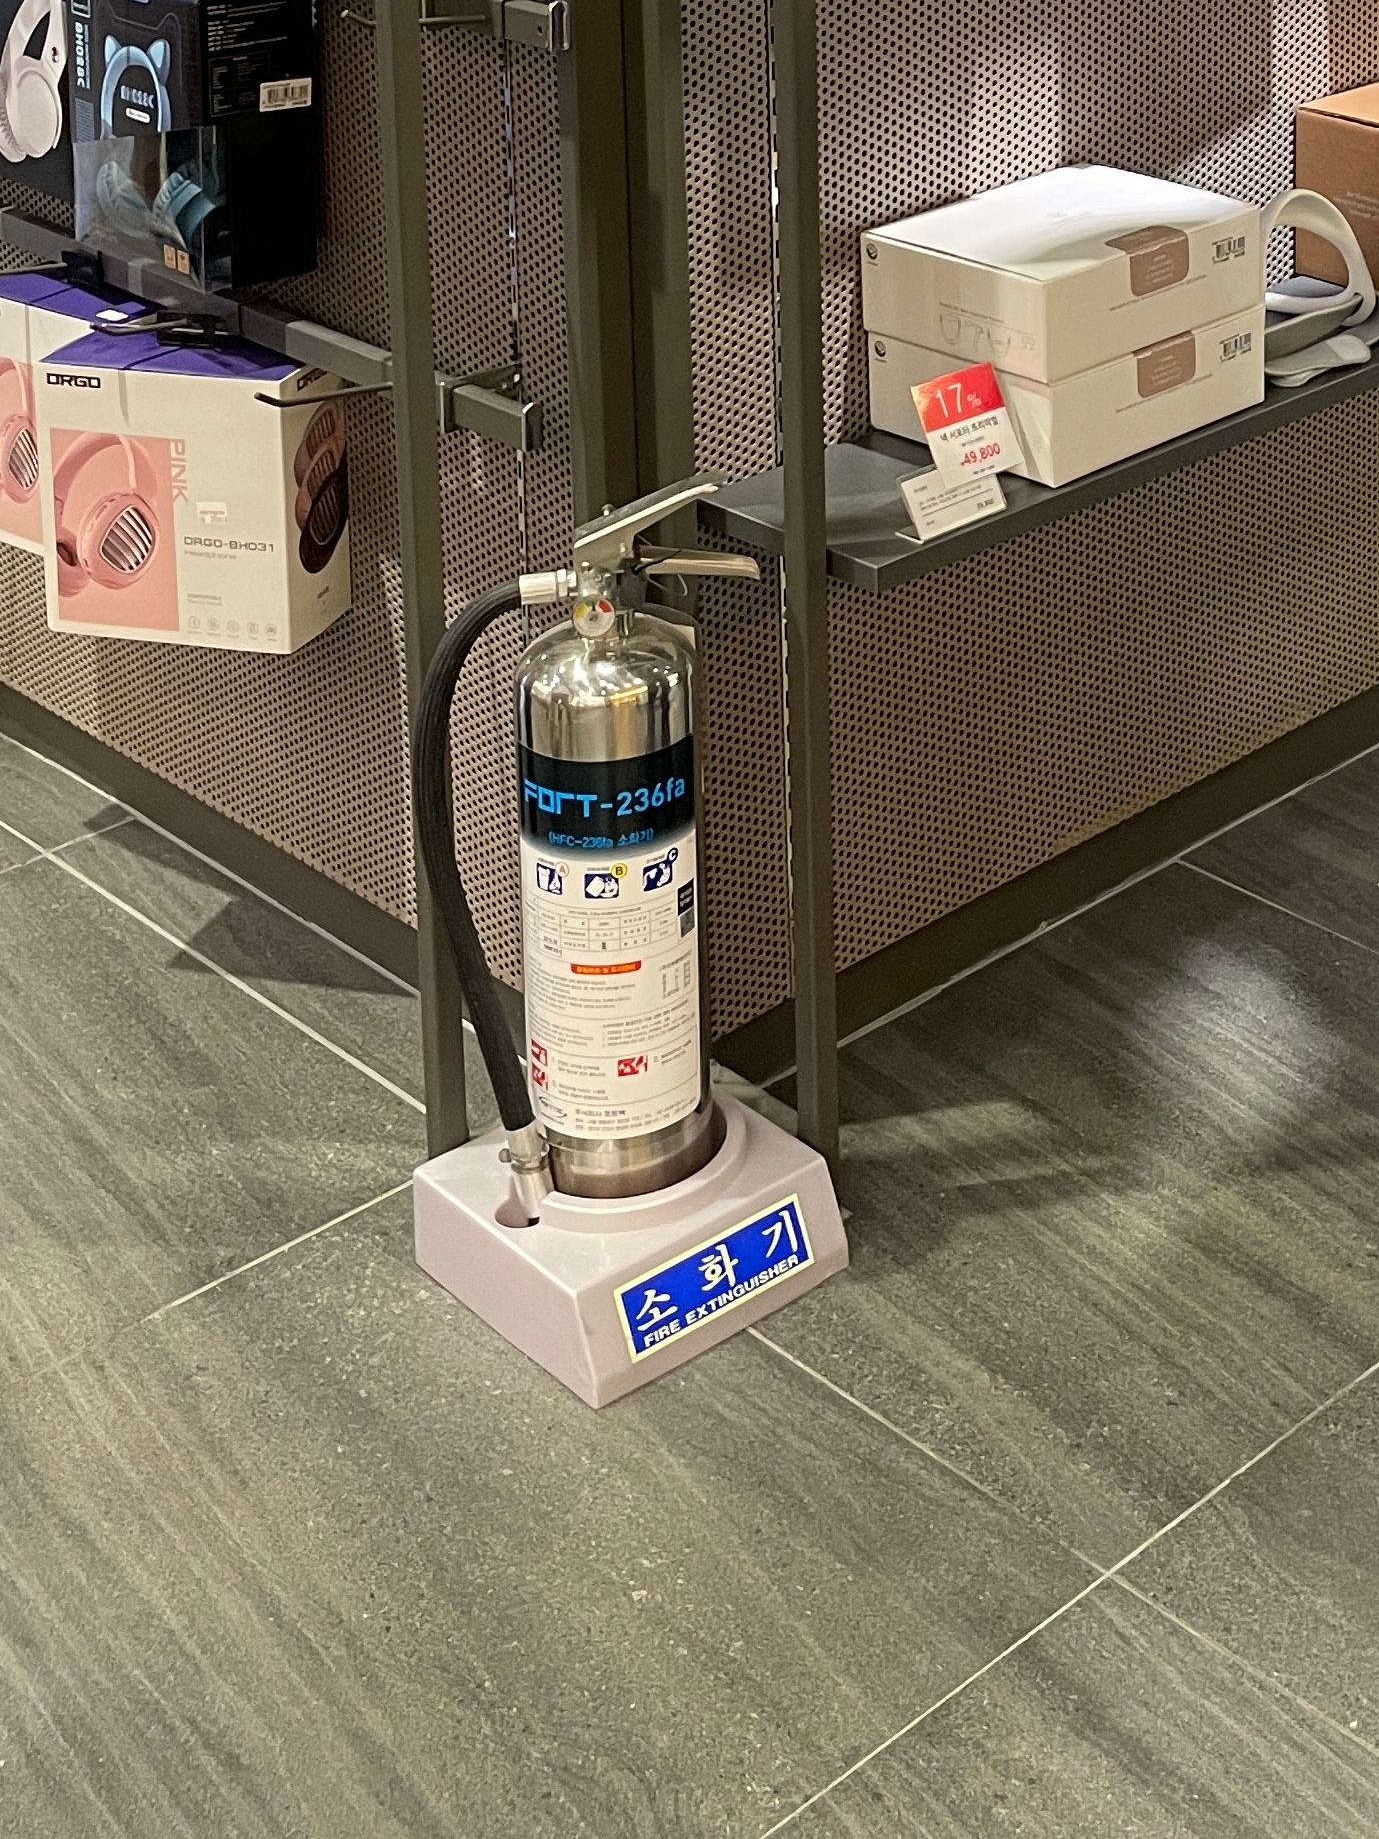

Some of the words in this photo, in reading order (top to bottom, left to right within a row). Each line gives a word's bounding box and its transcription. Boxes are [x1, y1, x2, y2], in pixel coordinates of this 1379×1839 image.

[170, 437, 188, 505] PINK
[615, 866, 624, 876] B
[643, 1318, 681, 1347] FIRE
[685, 1254, 799, 1325] EXTINGUISHER
